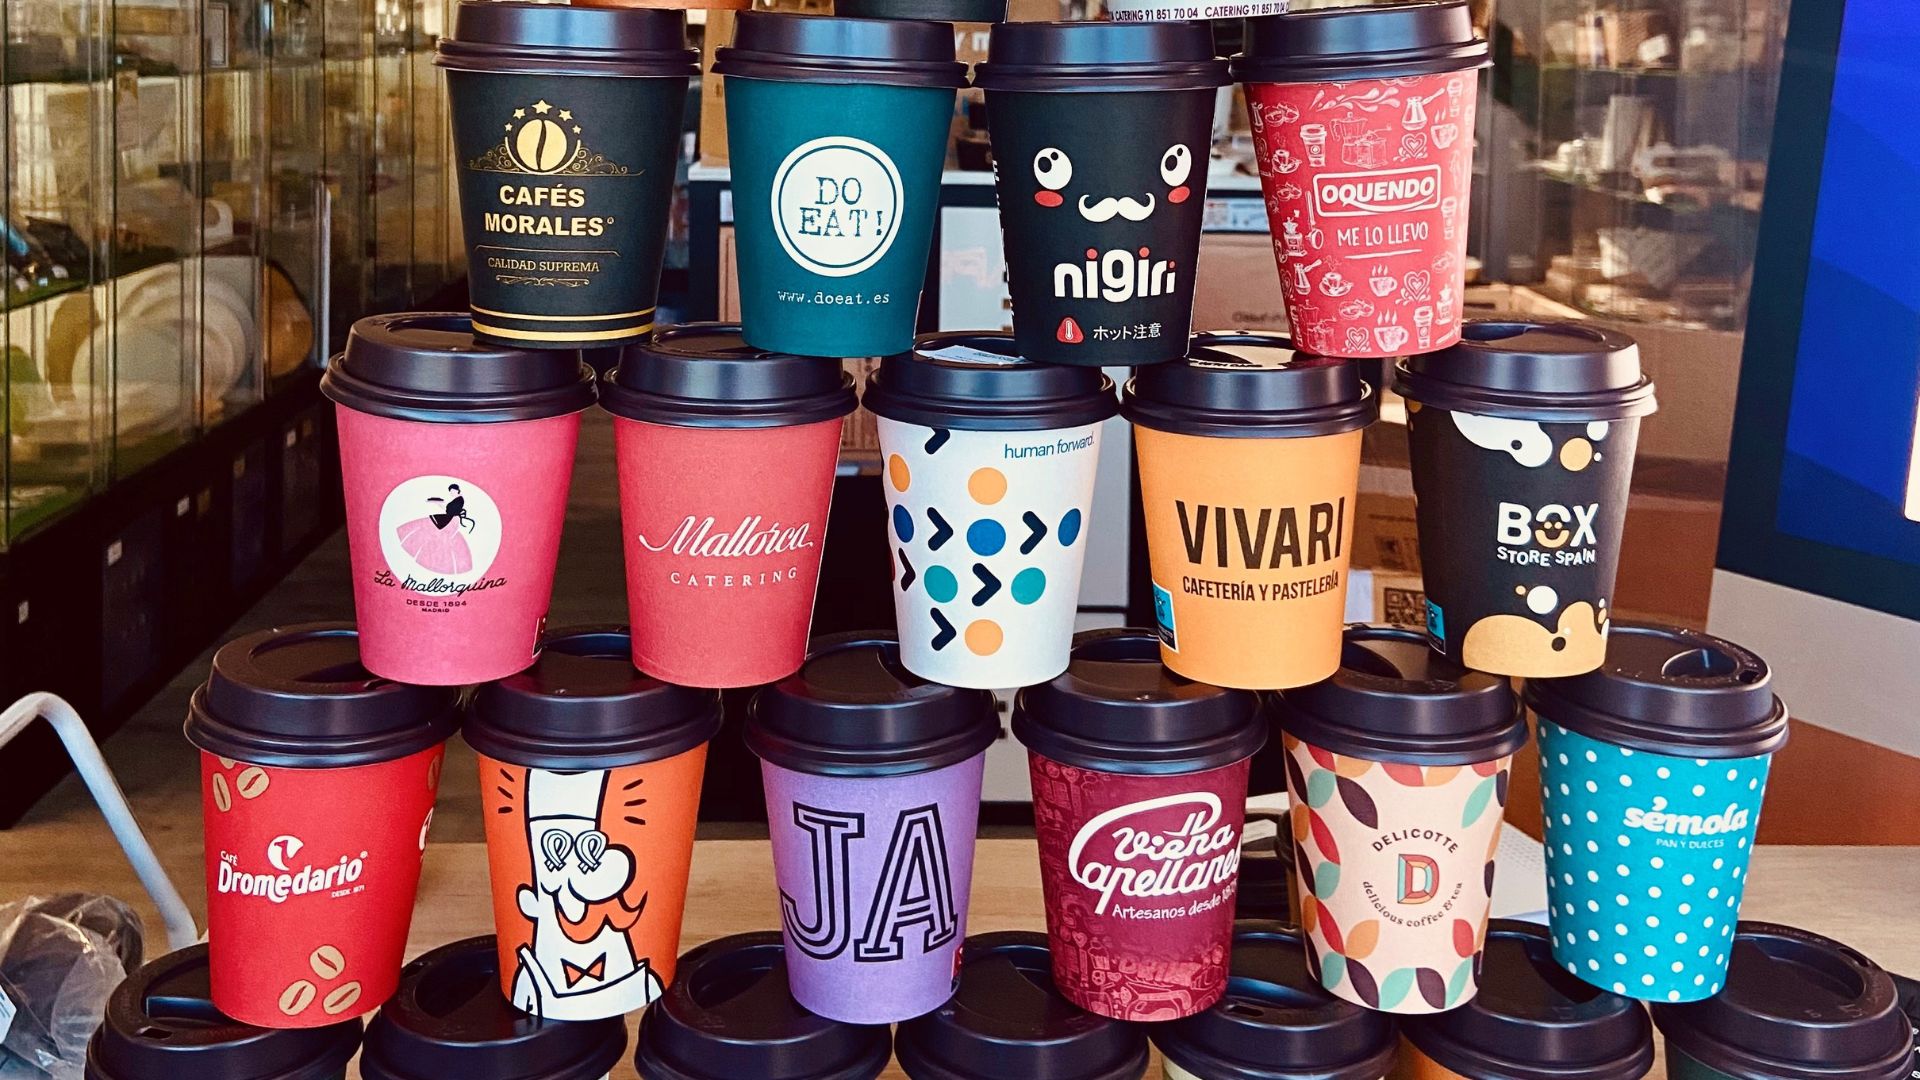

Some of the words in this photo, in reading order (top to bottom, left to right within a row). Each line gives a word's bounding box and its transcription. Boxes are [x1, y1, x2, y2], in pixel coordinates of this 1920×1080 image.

[1116, 10, 1143, 22] CATERING
[1145, 9, 1154, 21] 91
[1156, 8, 1171, 20] 851
[1174, 8, 1185, 19] 70
[1187, 7, 1199, 18] 04
[1205, 5, 1249, 18] CATERING
[1251, 4, 1260, 15] 91
[1261, 3, 1272, 14] 851
[499, 183, 585, 208] CAFÉS
[814, 176, 862, 205] DO
[1321, 176, 1435, 209] OQUENDO
[1337, 227, 1360, 247] ME
[1365, 226, 1383, 247] LO
[1387, 221, 1429, 245] LLEVO
[488, 257, 536, 271] CALIDAD
[539, 261, 600, 273] SUPREMA
[1053, 246, 1176, 303] nigiri
[777, 291, 890, 305] www.doeat.es
[1093, 322, 1162, 341] ホット注意
[1004, 443, 1055, 459] human
[639, 515, 813, 557] Mallorca
[1175, 496, 1345, 570] VIVARI
[1497, 502, 1599, 548] BOX
[1497, 546, 1551, 567] STORE
[1555, 548, 1596, 566] SPAIN
[374, 570, 396, 588] La
[401, 574, 507, 597] Mallorquina
[670, 566, 798, 587] CATERING
[1183, 575, 1255, 601] CAFETERÍA
[1259, 584, 1268, 601] Y
[1272, 569, 1339, 601] PASTELERÍA
[406, 599, 439, 607] DESDE
[1623, 796, 1749, 835] sémola
[1112, 822, 1234, 862] Viena
[1371, 828, 1459, 854] DELICOTTE
[1656, 838, 1678, 848] PAN
[1680, 839, 1687, 848] Y
[1688, 839, 1725, 849] DULCES
[218, 855, 363, 904] Dromedario
[779, 800, 959, 963] JA
[1112, 904, 1186, 920] Artesanos
[1188, 894, 1221, 917] desde
[1363, 881, 1403, 925] delicious
[1406, 911, 1444, 928] coffee
[1451, 882, 1463, 900] tea
